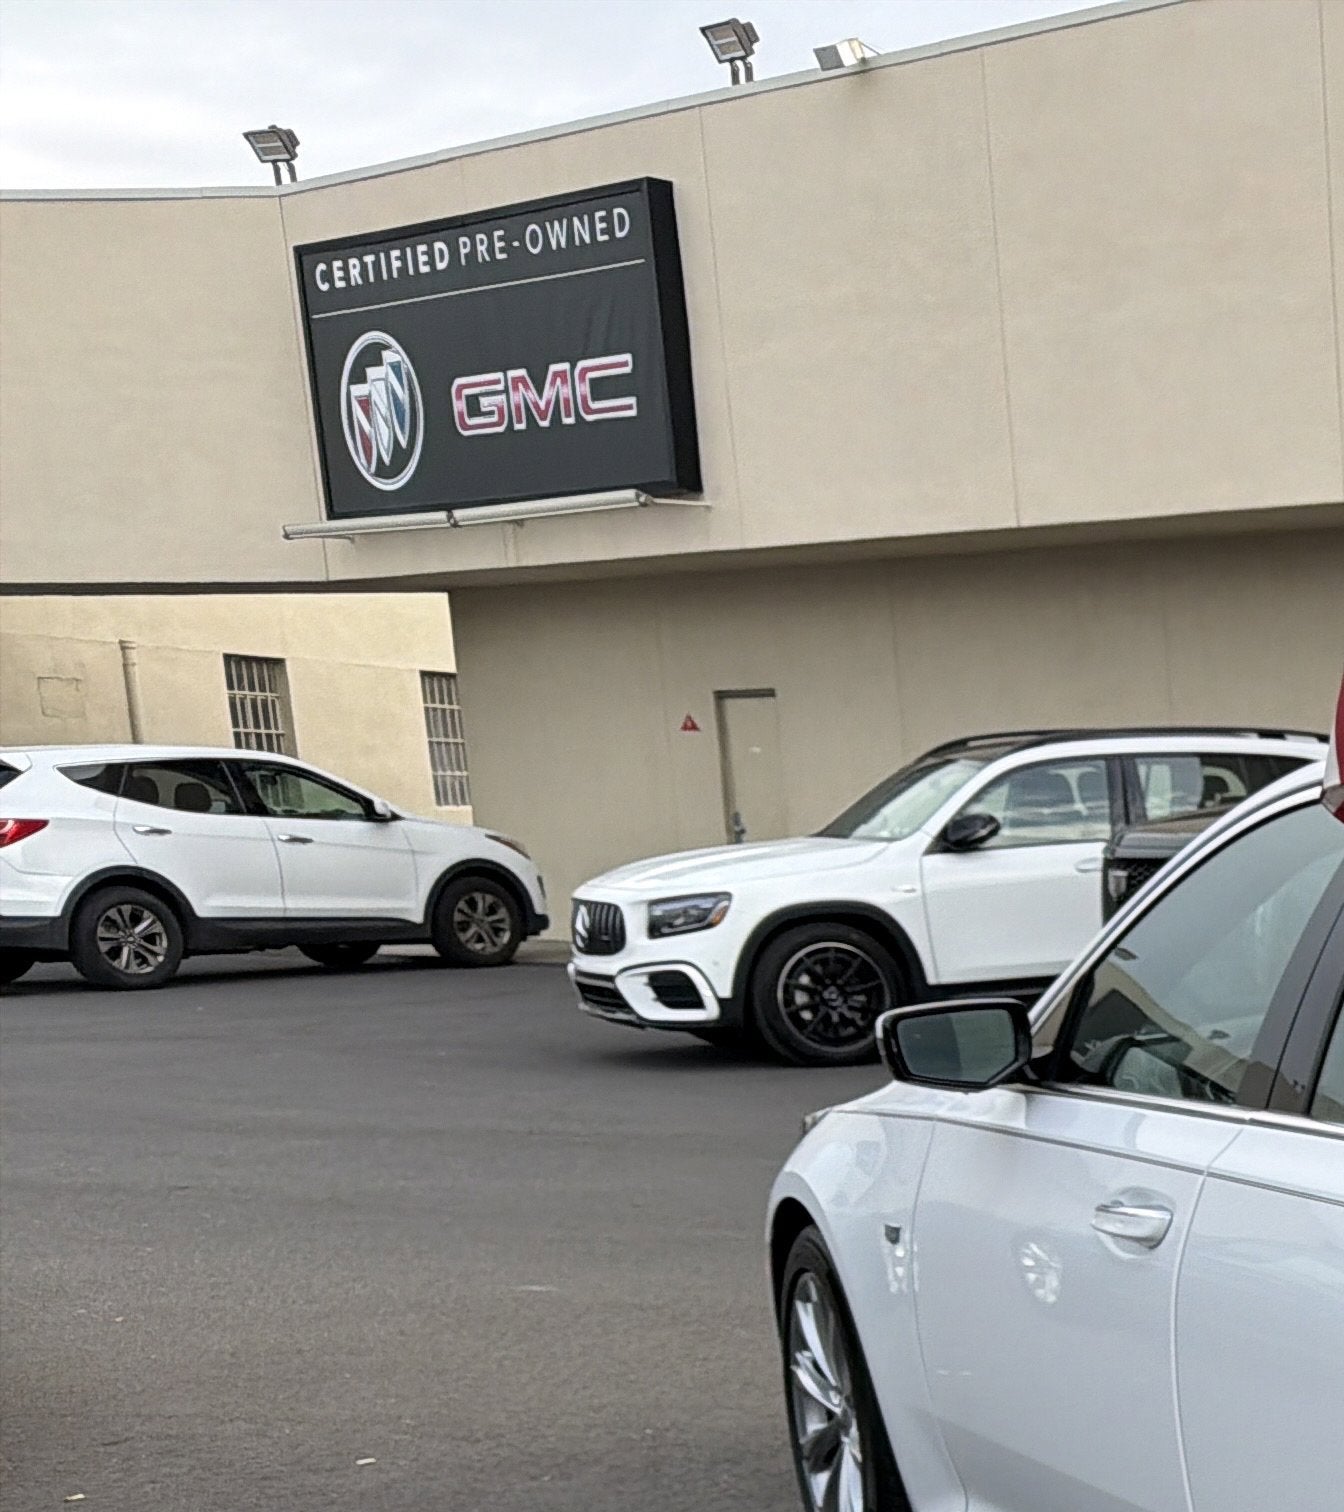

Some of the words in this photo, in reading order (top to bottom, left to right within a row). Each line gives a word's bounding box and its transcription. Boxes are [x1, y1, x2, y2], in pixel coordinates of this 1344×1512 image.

[315, 241, 450, 291] CERTIFIED
[458, 207, 631, 266] PRE-OWNED
[451, 353, 638, 437] GMC
